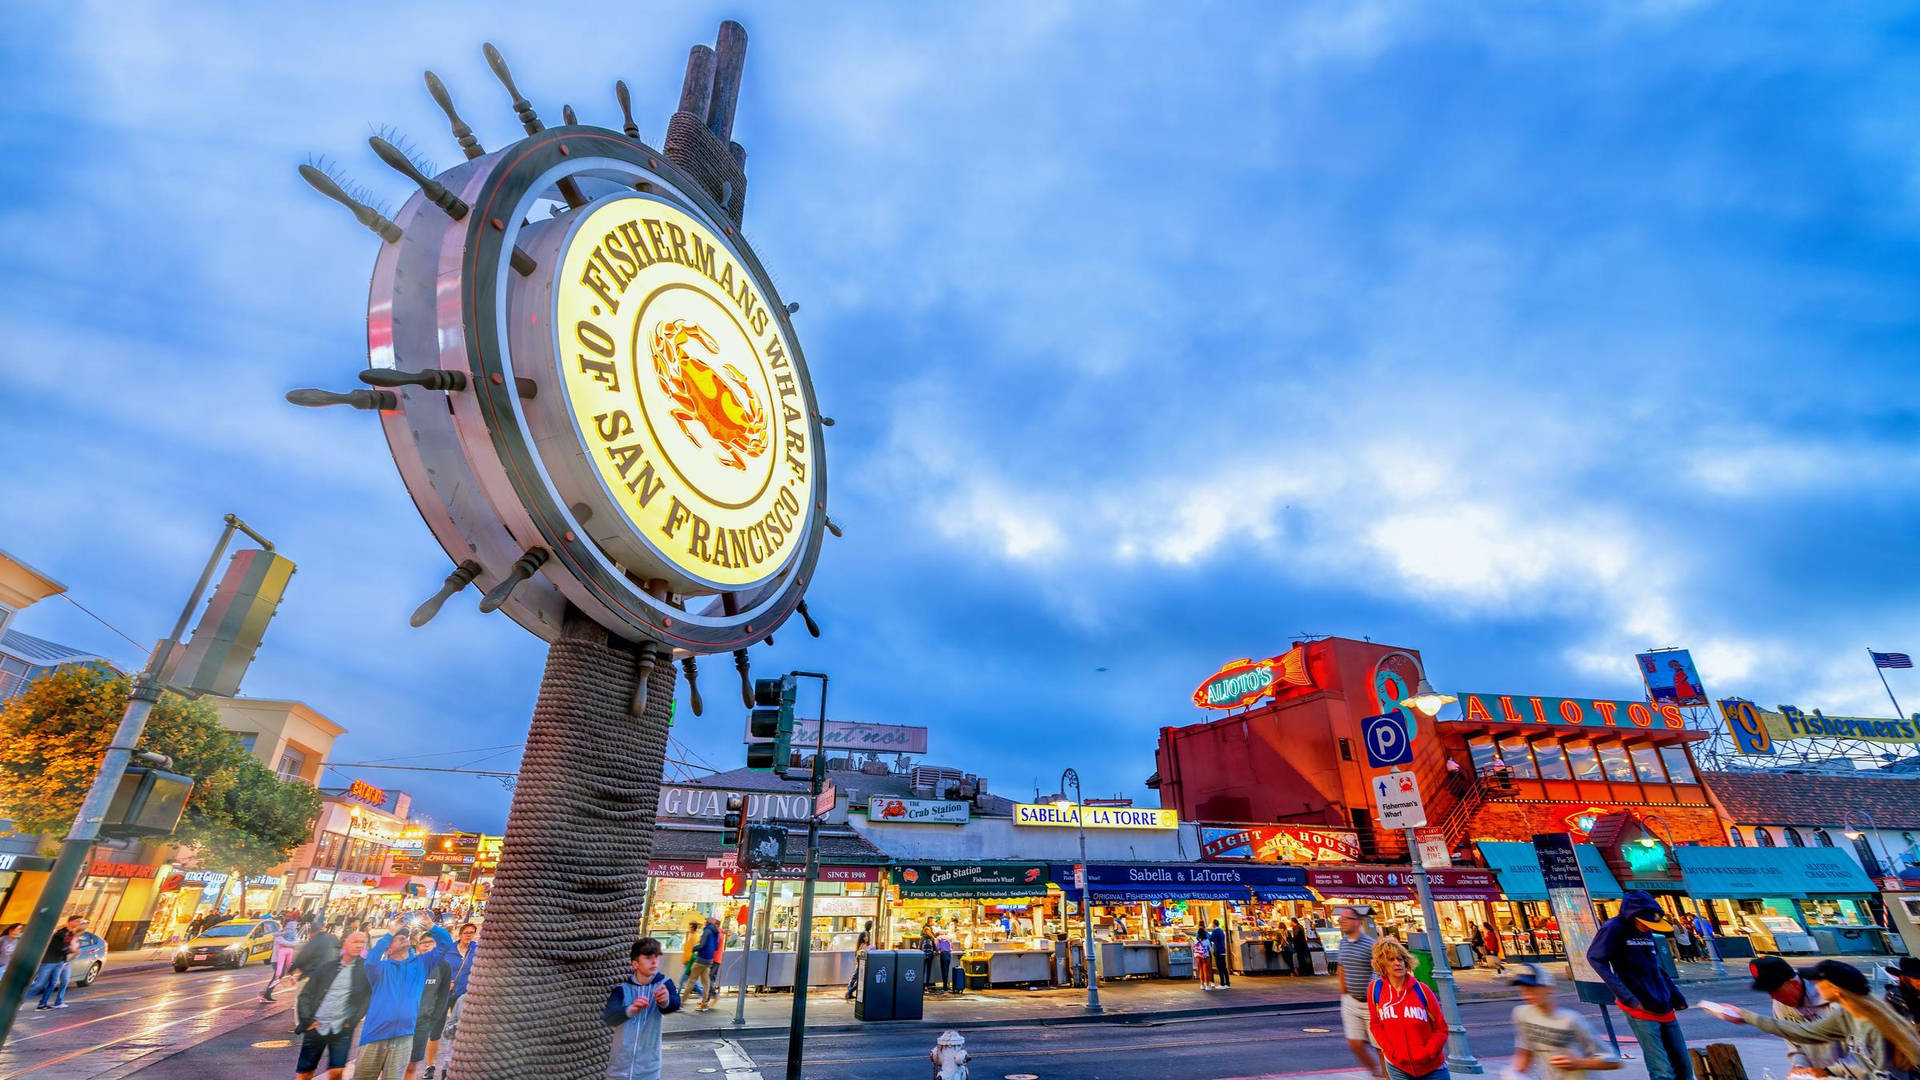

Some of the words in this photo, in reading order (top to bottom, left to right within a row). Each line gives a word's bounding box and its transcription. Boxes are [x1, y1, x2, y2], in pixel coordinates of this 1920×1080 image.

[575, 318, 620, 393] OF
[580, 218, 769, 338] FISHERMANS
[764, 334, 807, 484] WHARF
[593, 408, 666, 511] SAN
[658, 484, 801, 570] FRANCISCO
[1207, 666, 1274, 704] ALIOTO'S
[1466, 695, 1685, 729] ALIOTO'S
[1737, 702, 1770, 751] 9
[1777, 704, 1914, 739] Fishermen's
[908, 809, 930, 819] Crab
[931, 803, 962, 815] Station
[1021, 807, 1080, 823] SABELLA
[1093, 810, 1111, 824] LA
[1113, 811, 1158, 826] TORRE
[1382, 801, 1419, 810] Fisherman's
[1204, 830, 1263, 856] LIGHT
[1299, 831, 1360, 858] HOUSE
[931, 871, 952, 883] Crab
[953, 866, 982, 878] Station
[1129, 868, 1173, 881] Sabella
[1177, 872, 1186, 882] &
[1190, 869, 1241, 882] LaTorre's
[1356, 872, 1385, 885] NICK'S
[1400, 873, 1445, 885] LIGOUSE
[1093, 892, 1125, 900] ORIGINAL
[1125, 892, 1169, 900] FISHERMAN'S
[1191, 892, 1230, 900] RESTAURANT
